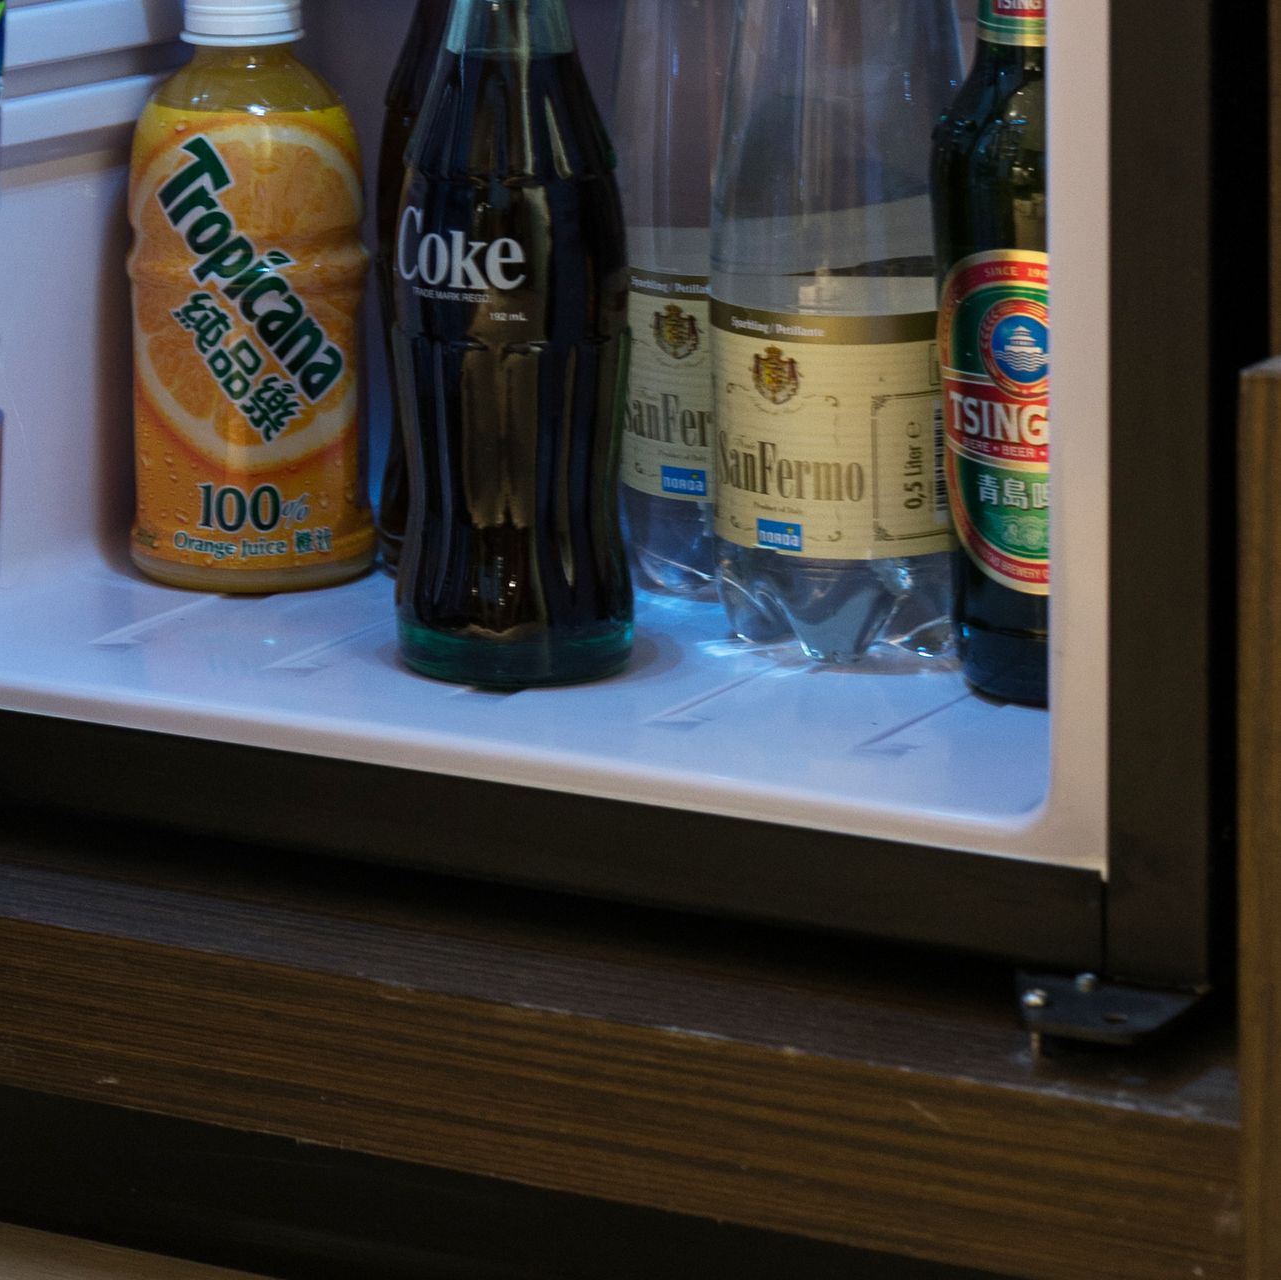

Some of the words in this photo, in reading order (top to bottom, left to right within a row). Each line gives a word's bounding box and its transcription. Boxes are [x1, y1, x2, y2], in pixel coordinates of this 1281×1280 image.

[157, 135, 345, 401] Tropicana
[398, 205, 527, 291] Coke
[983, 265, 1019, 278] SINCE
[731, 315, 769, 335] Sparkling
[719, 429, 864, 502] SanFermo
[1001, 444, 1035, 459] BEER
[197, 482, 310, 533] 100%
[174, 530, 238, 561] Orange
